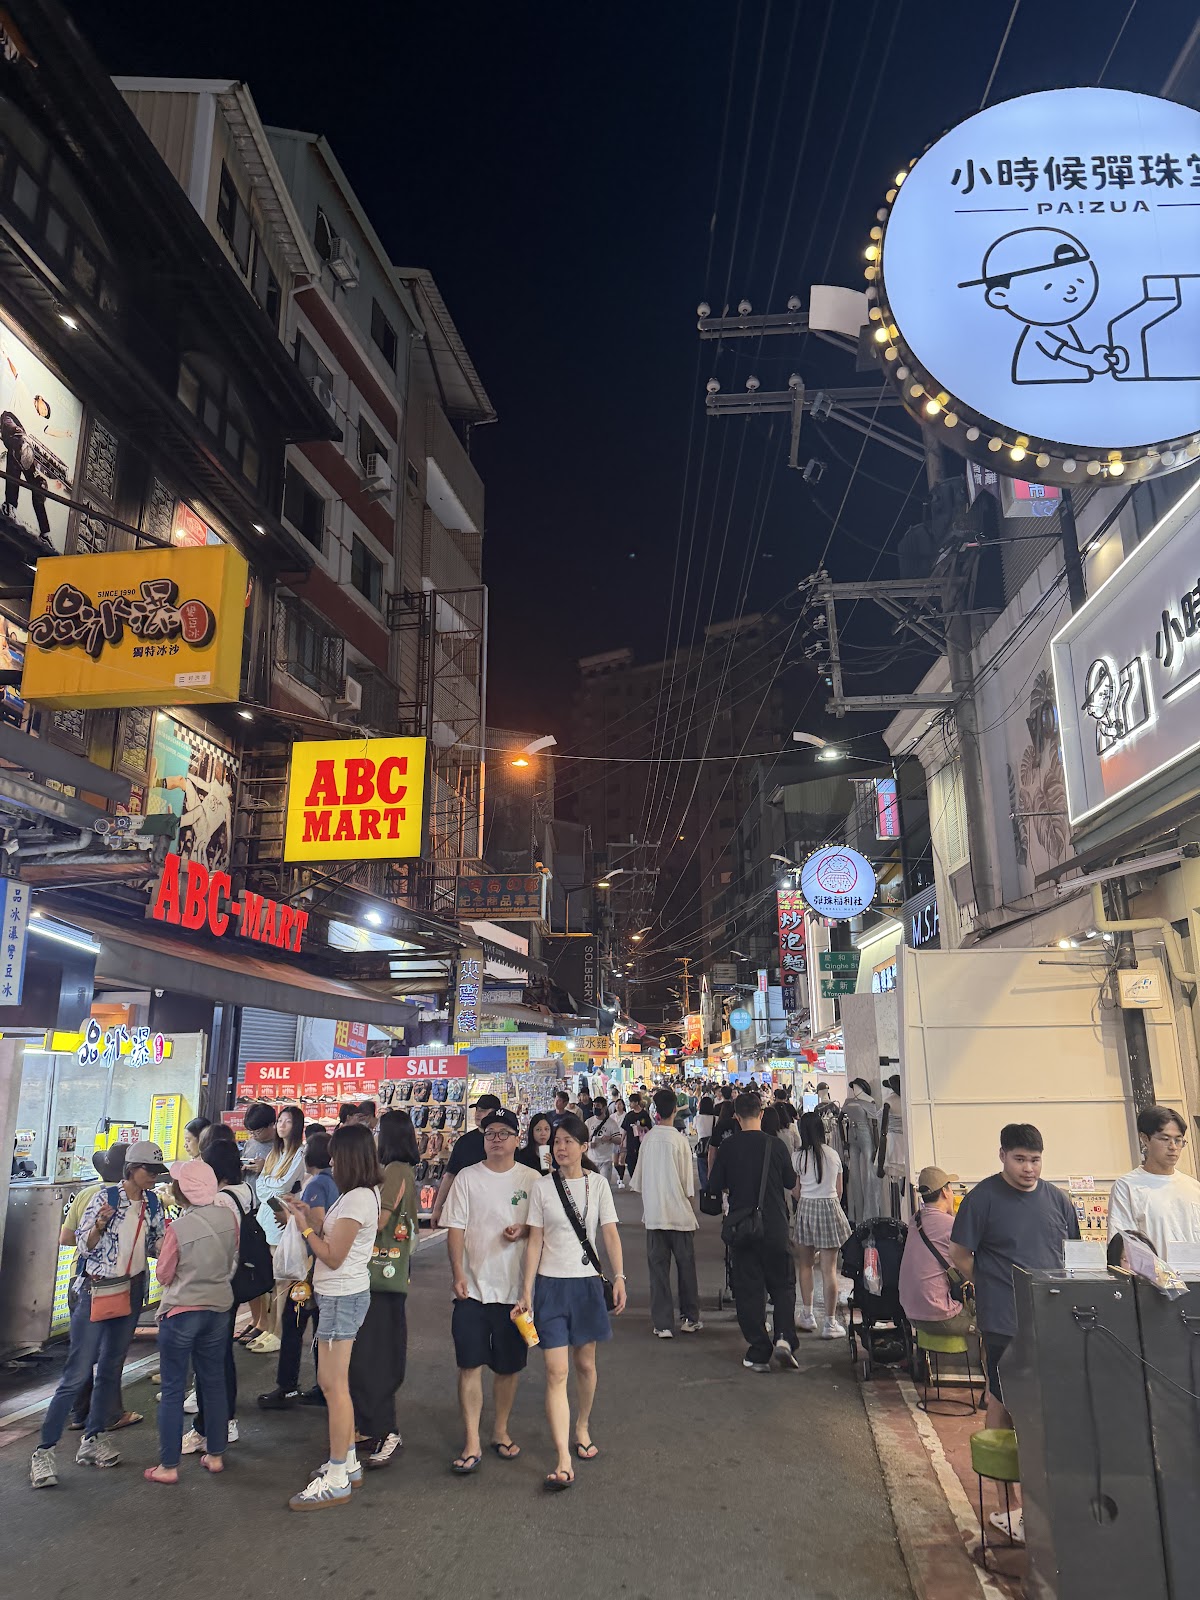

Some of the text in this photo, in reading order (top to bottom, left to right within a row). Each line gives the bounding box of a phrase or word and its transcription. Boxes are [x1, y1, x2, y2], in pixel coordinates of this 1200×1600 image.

[1037, 200, 1151, 215] PA!ZUA
[97, 588, 136, 598] SINCE 1990
[133, 644, 180, 658] 獨特冰沙
[305, 756, 408, 807] ABC
[302, 808, 406, 842] MART
[153, 853, 309, 953] ABC-MART
[813, 895, 863, 906] 彈珠福利社
[780, 911, 807, 974] 炒泡麵
[584, 945, 594, 1004] SOLBERRY
[574, 1037, 607, 1049] 鹽水雞
[259, 1066, 291, 1080] SALE
[324, 1062, 366, 1079] SALE
[406, 1059, 448, 1075] SALE
